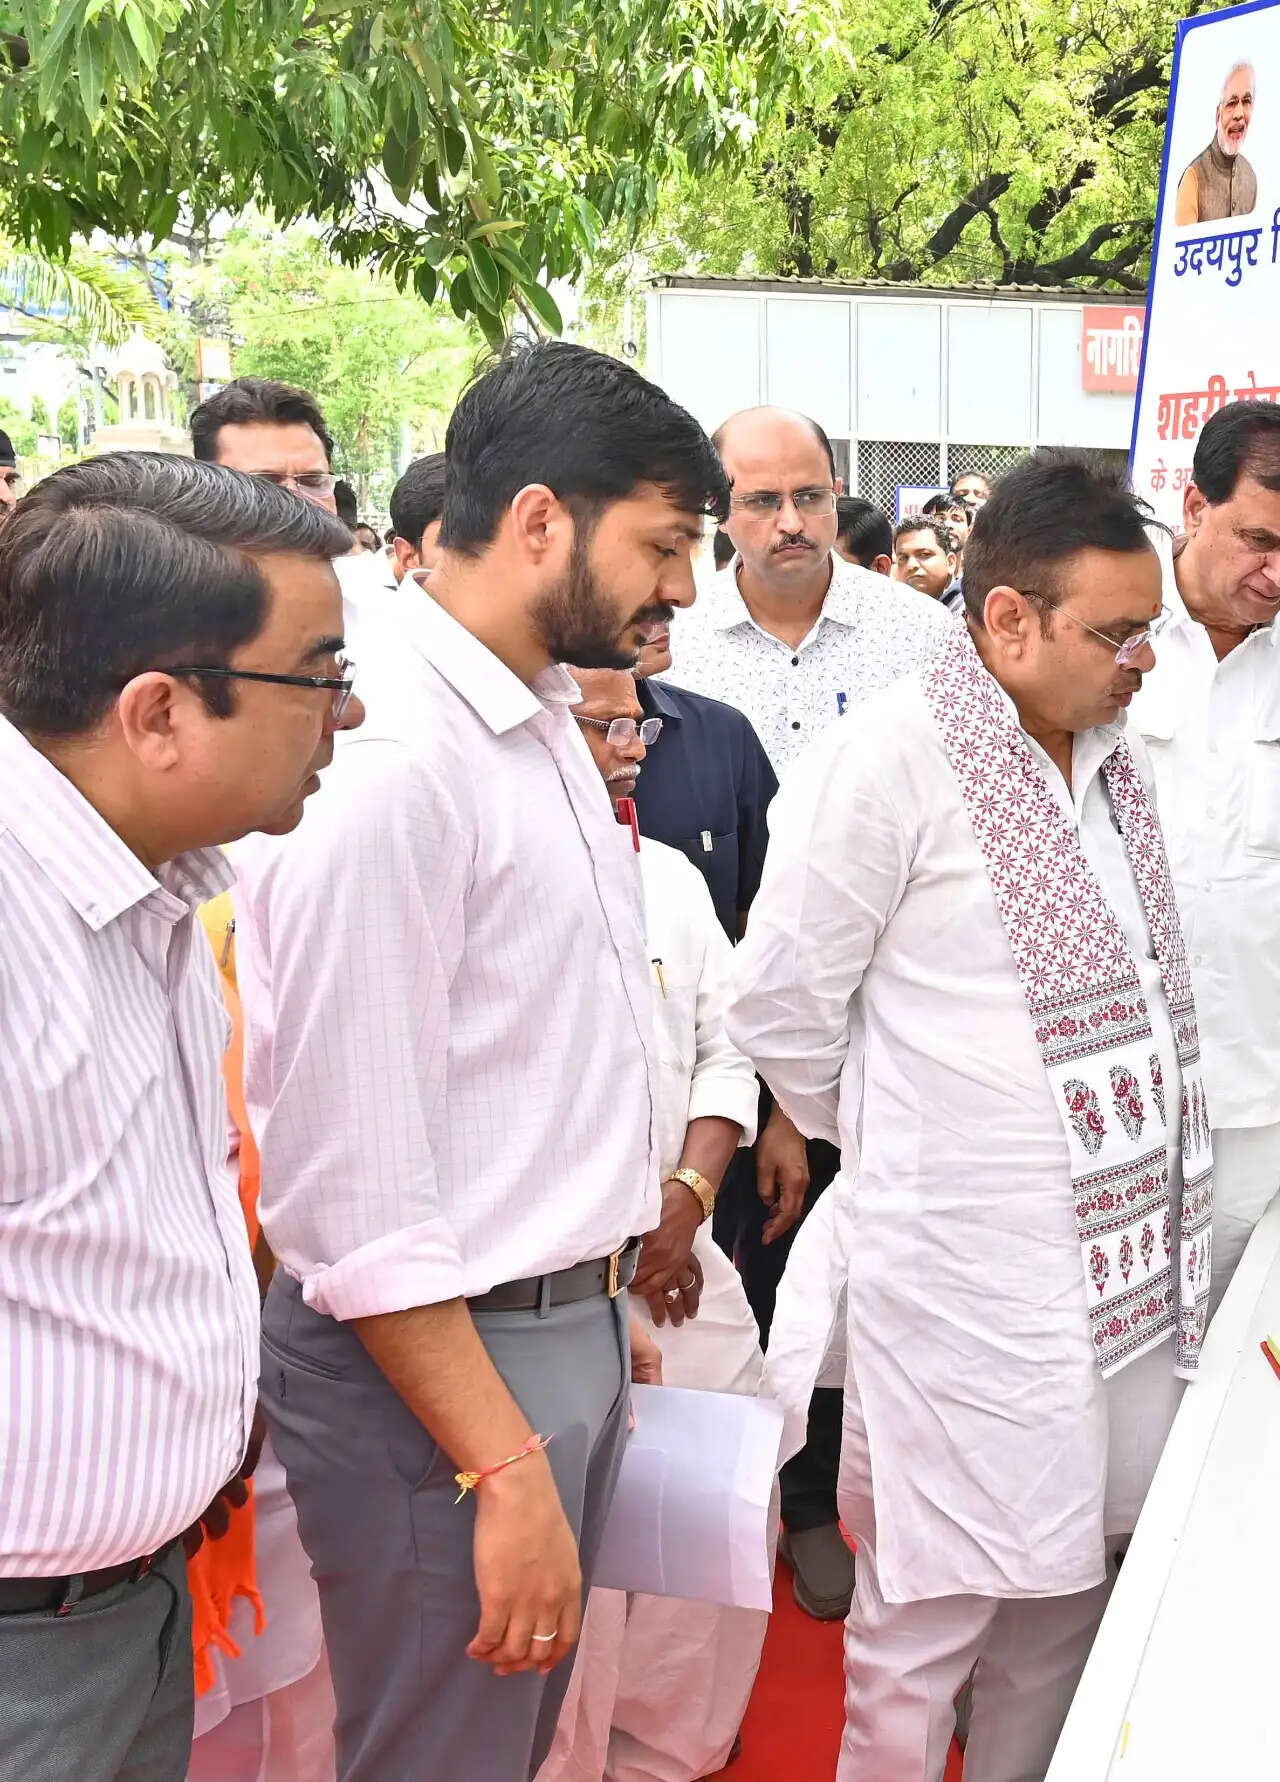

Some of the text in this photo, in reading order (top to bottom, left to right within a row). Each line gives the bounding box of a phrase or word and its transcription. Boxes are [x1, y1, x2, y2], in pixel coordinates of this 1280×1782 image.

[1174, 228, 1263, 287] उदयपुर
[1087, 315, 1144, 376] नागरि
[1150, 458, 1168, 492] के
